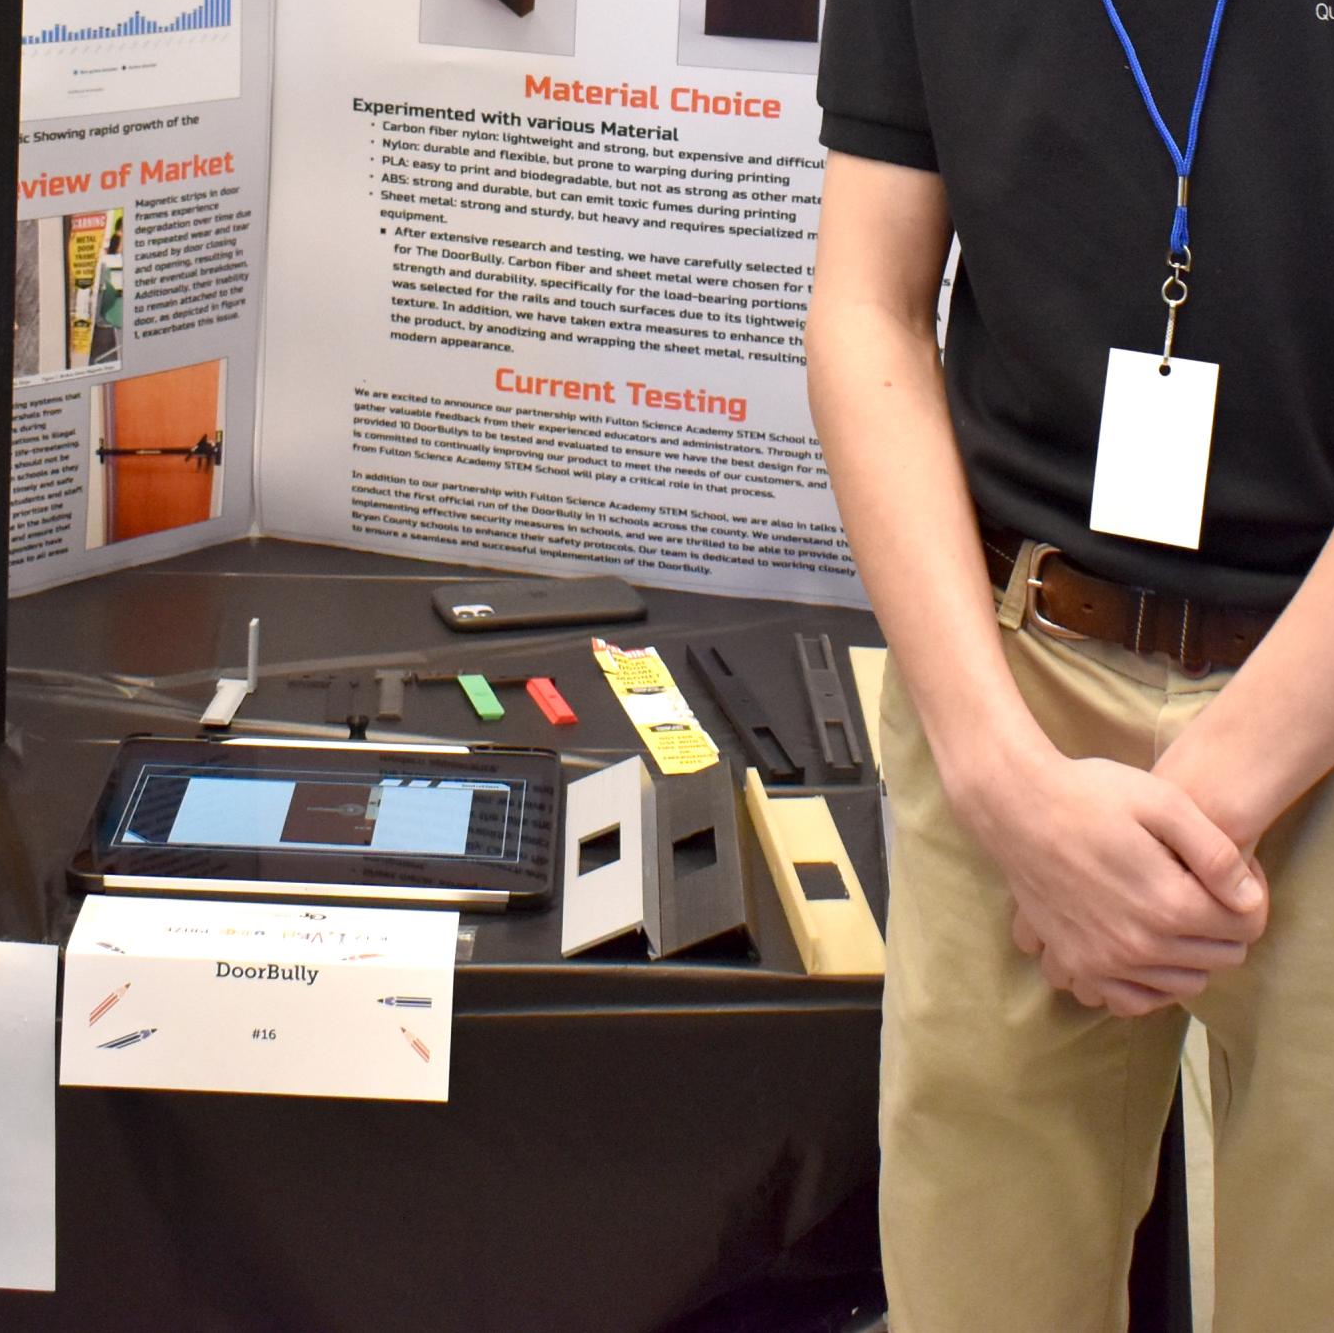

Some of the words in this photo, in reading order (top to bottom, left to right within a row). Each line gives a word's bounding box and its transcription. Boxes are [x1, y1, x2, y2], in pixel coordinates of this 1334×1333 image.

[524, 73, 659, 110] Material
[670, 86, 781, 119] Choice
[33, 128, 86, 143] Showing
[89, 123, 119, 137] rapid
[122, 119, 163, 135] growth
[166, 116, 179, 128] of
[181, 115, 199, 126] the
[353, 97, 475, 126] Experimented
[481, 111, 521, 127] with
[527, 116, 595, 134] various
[601, 121, 679, 141] Material
[99, 163, 132, 191] of
[140, 153, 234, 185] Market
[382, 138, 419, 151] Nylon:
[423, 142, 470, 156] durable
[473, 149, 496, 158] and
[499, 149, 549, 164] flexible,
[553, 154, 574, 166] but
[577, 159, 614, 170] prone
[617, 162, 630, 172] to
[634, 165, 686, 179] warping
[690, 168, 733, 183] during
[737, 172, 790, 187] printing
[135, 197, 178, 209] Magnetic
[181, 191, 208, 203] strips
[210, 190, 218, 198] in
[220, 186, 241, 196] door
[135, 210, 169, 221] frames
[171, 203, 220, 217] experience
[493, 366, 614, 404] Current
[627, 380, 747, 423] Testing
[216, 961, 319, 986] DoorBully
[252, 1028, 276, 1040] #16
